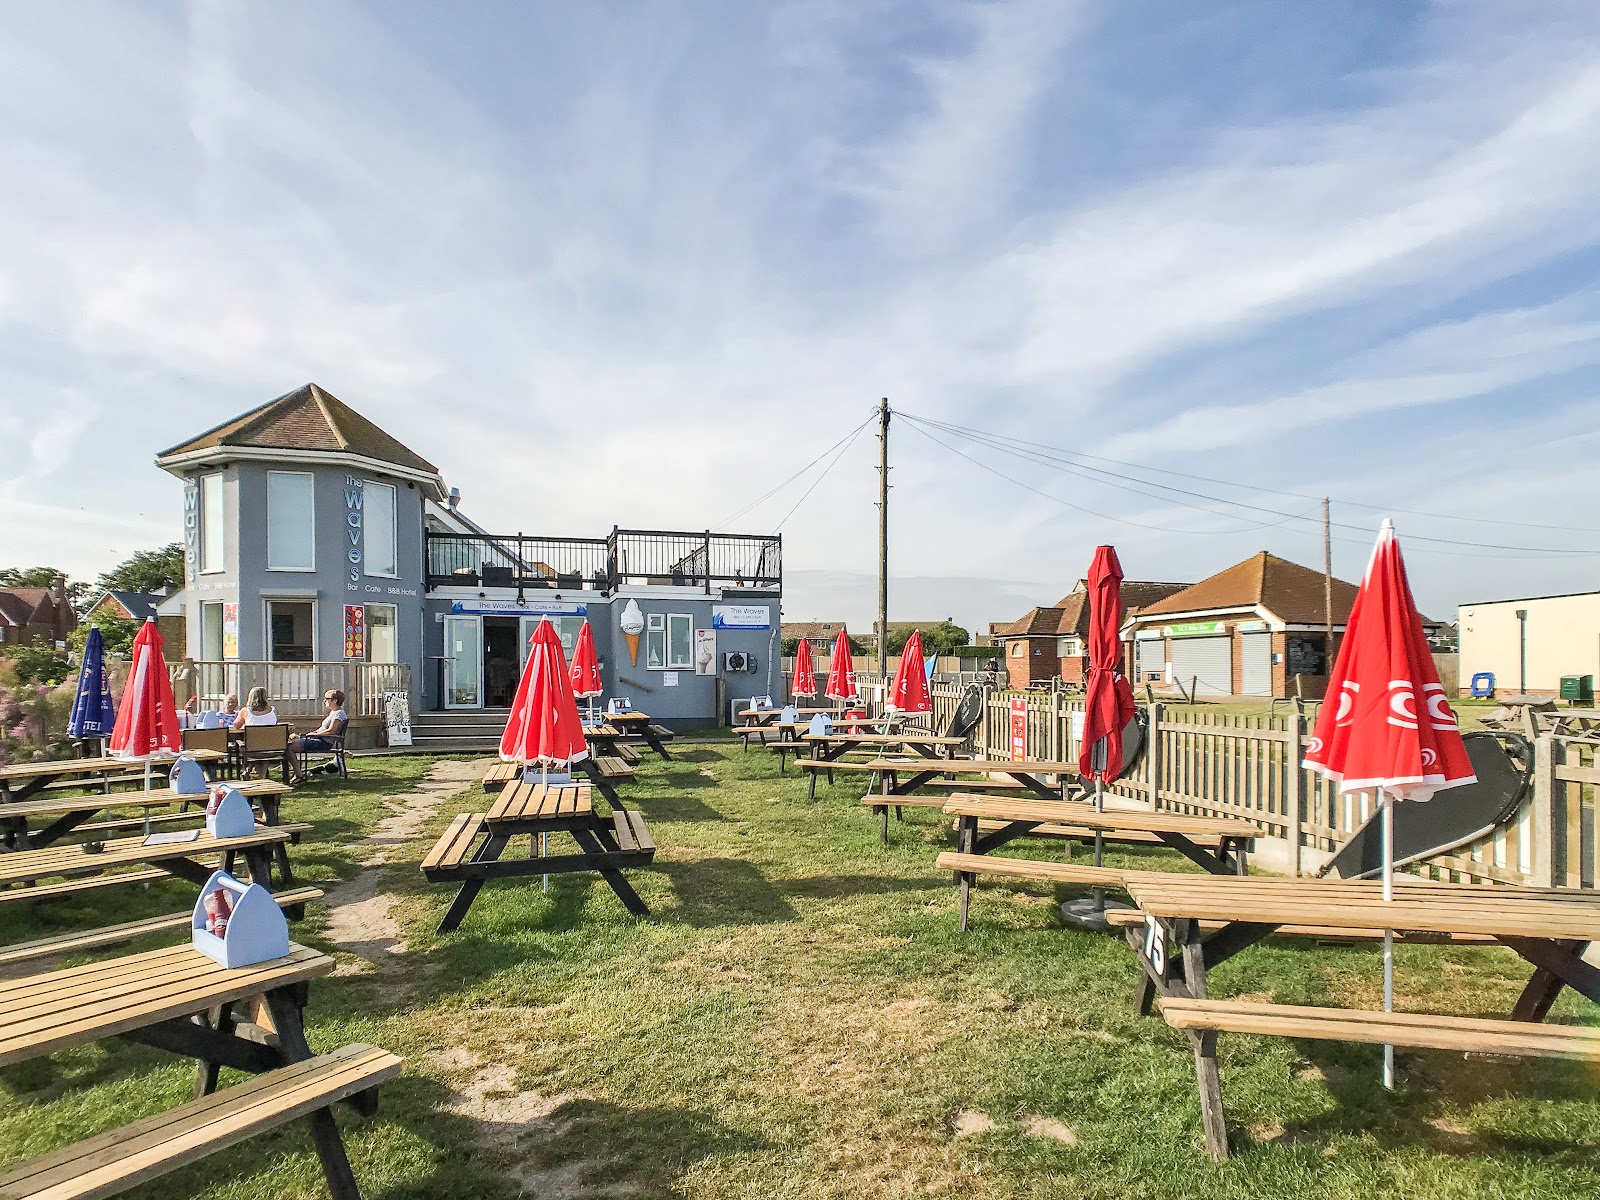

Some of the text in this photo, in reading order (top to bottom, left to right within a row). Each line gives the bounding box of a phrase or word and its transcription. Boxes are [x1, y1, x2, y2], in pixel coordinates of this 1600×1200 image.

[345, 474, 363, 487] The
[184, 487, 198, 582] Waves
[343, 488, 363, 582] Waves
[347, 583, 358, 591] Bar
[387, 587, 400, 595] B&B
[401, 588, 417, 596] Hotel
[731, 607, 742, 615] The
[1144, 914, 1165, 976] 75
